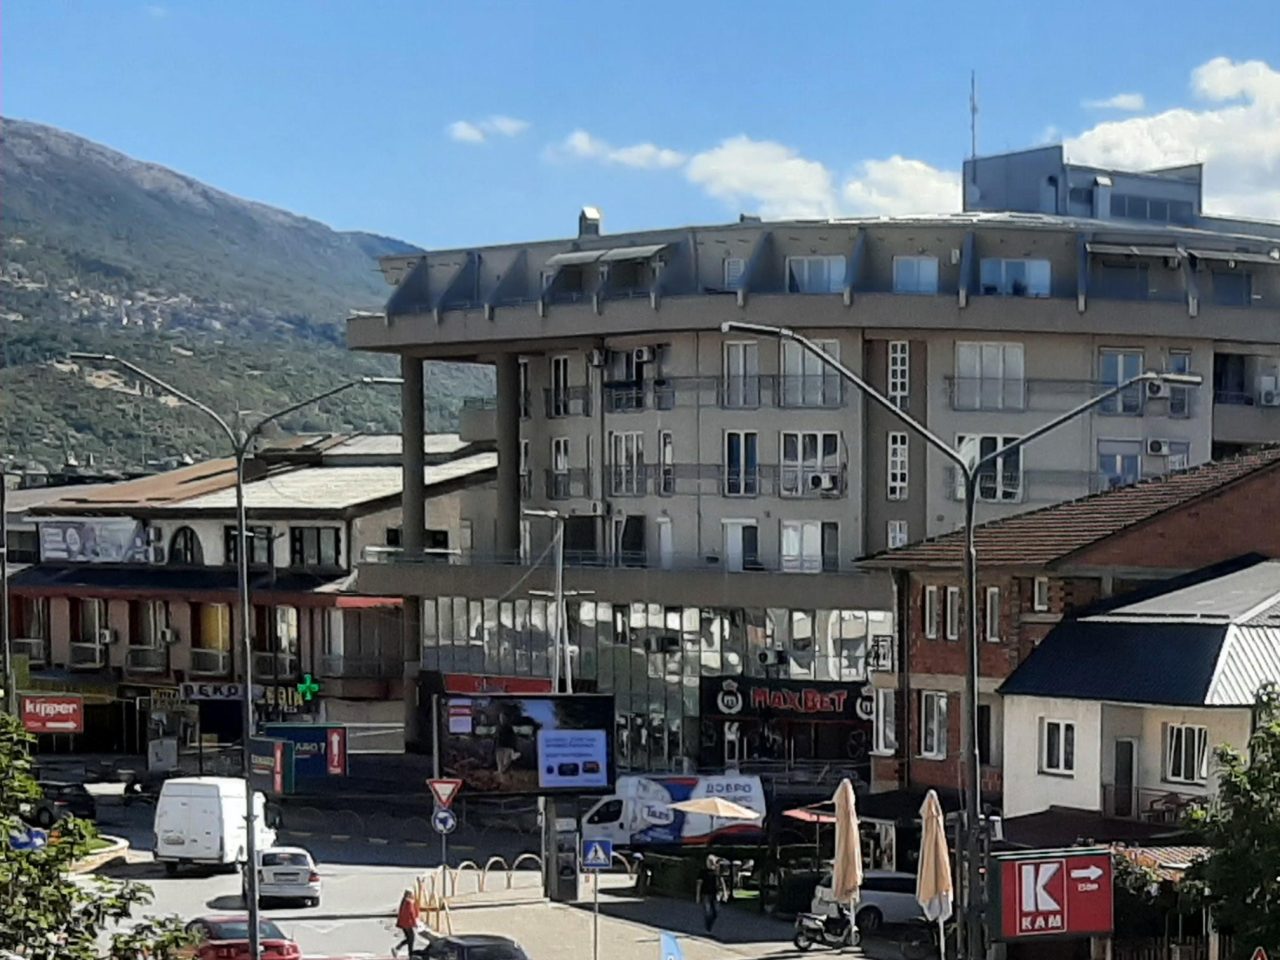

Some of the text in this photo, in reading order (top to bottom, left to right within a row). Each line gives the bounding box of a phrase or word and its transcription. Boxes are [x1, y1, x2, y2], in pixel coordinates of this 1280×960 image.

[25, 698, 78, 718] kipper
[1021, 862, 1062, 912] K
[1021, 914, 1062, 930] KAM
